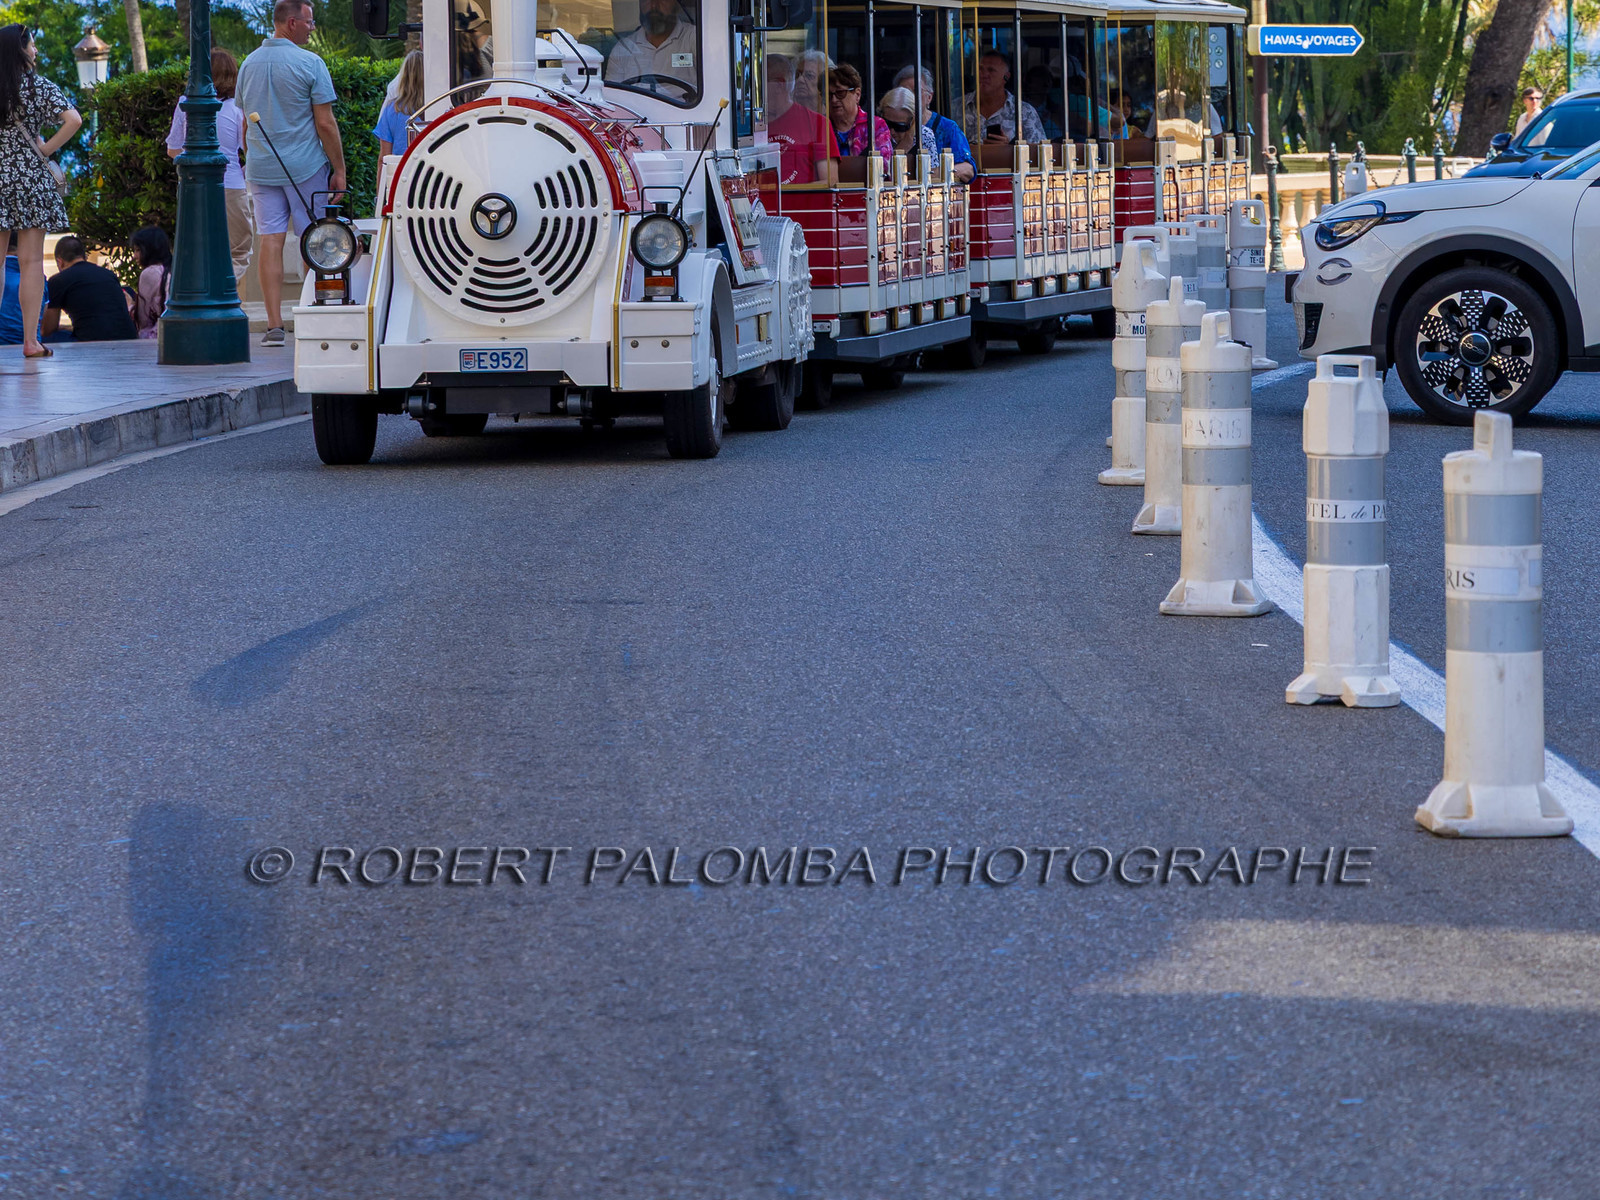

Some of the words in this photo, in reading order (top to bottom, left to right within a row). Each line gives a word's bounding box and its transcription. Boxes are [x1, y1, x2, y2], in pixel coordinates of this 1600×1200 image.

[1264, 34, 1302, 46] HAVAS
[1306, 35, 1357, 47] VOYAGES
[477, 351, 525, 370] E952
[1307, 502, 1346, 519] TEL
[1350, 505, 1367, 519] de
